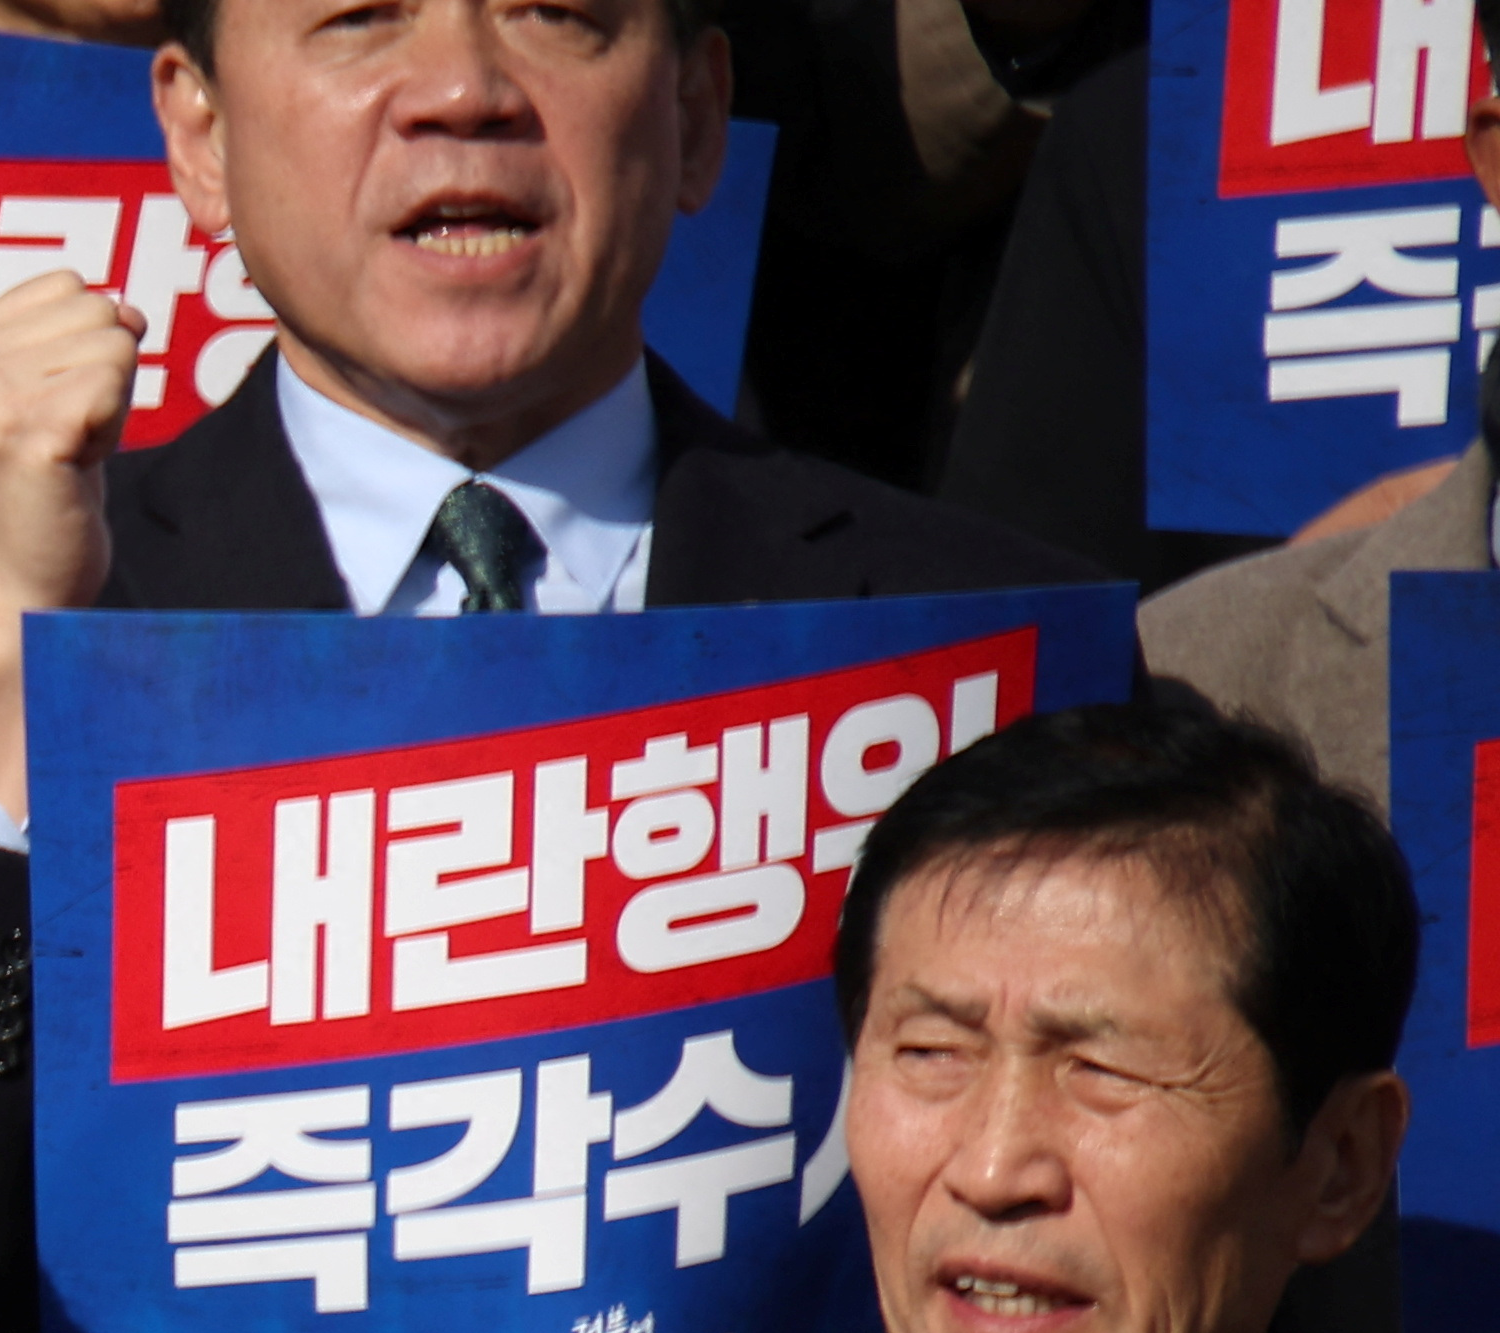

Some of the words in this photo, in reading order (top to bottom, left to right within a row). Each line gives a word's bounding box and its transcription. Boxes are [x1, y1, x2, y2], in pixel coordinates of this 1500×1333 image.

[1270, 0, 1499, 146] 내
[1264, 205, 1500, 428] 즉
[167, 1028, 850, 1315] 즉각수
